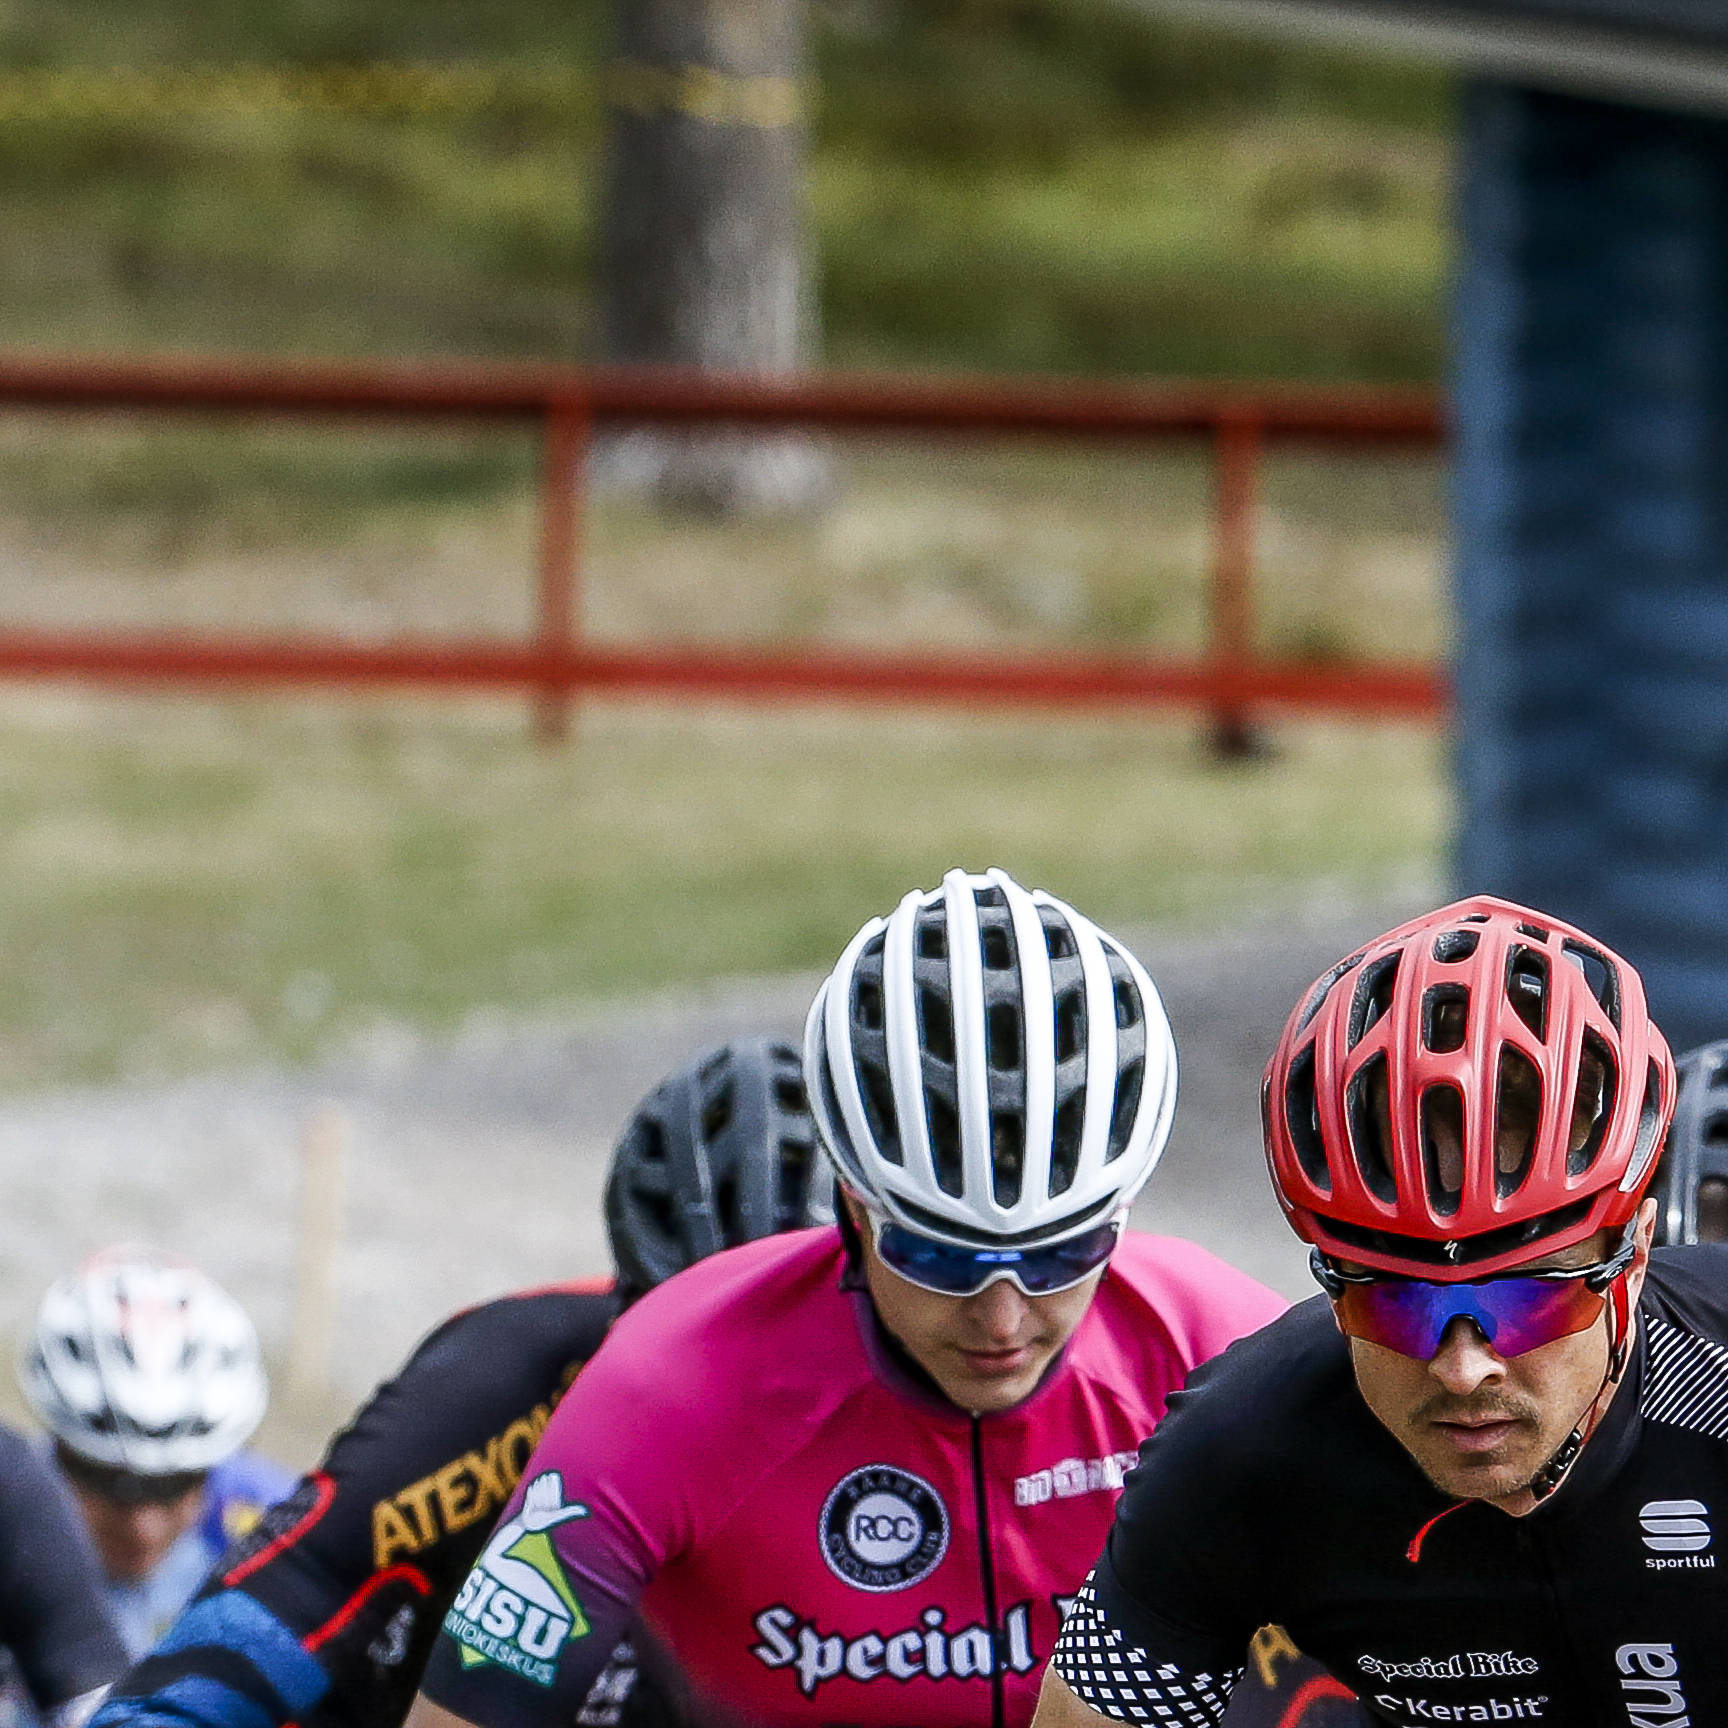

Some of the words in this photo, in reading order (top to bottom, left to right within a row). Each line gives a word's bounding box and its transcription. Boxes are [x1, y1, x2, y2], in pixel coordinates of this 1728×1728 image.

[855, 1514, 916, 1542] RCC
[1645, 1555, 1715, 1570] sportful
[454, 1567, 572, 1659] SISU
[754, 1605, 1034, 1694] Special
[1357, 1654, 1465, 1683] Special
[1467, 1650, 1539, 1677] Bike
